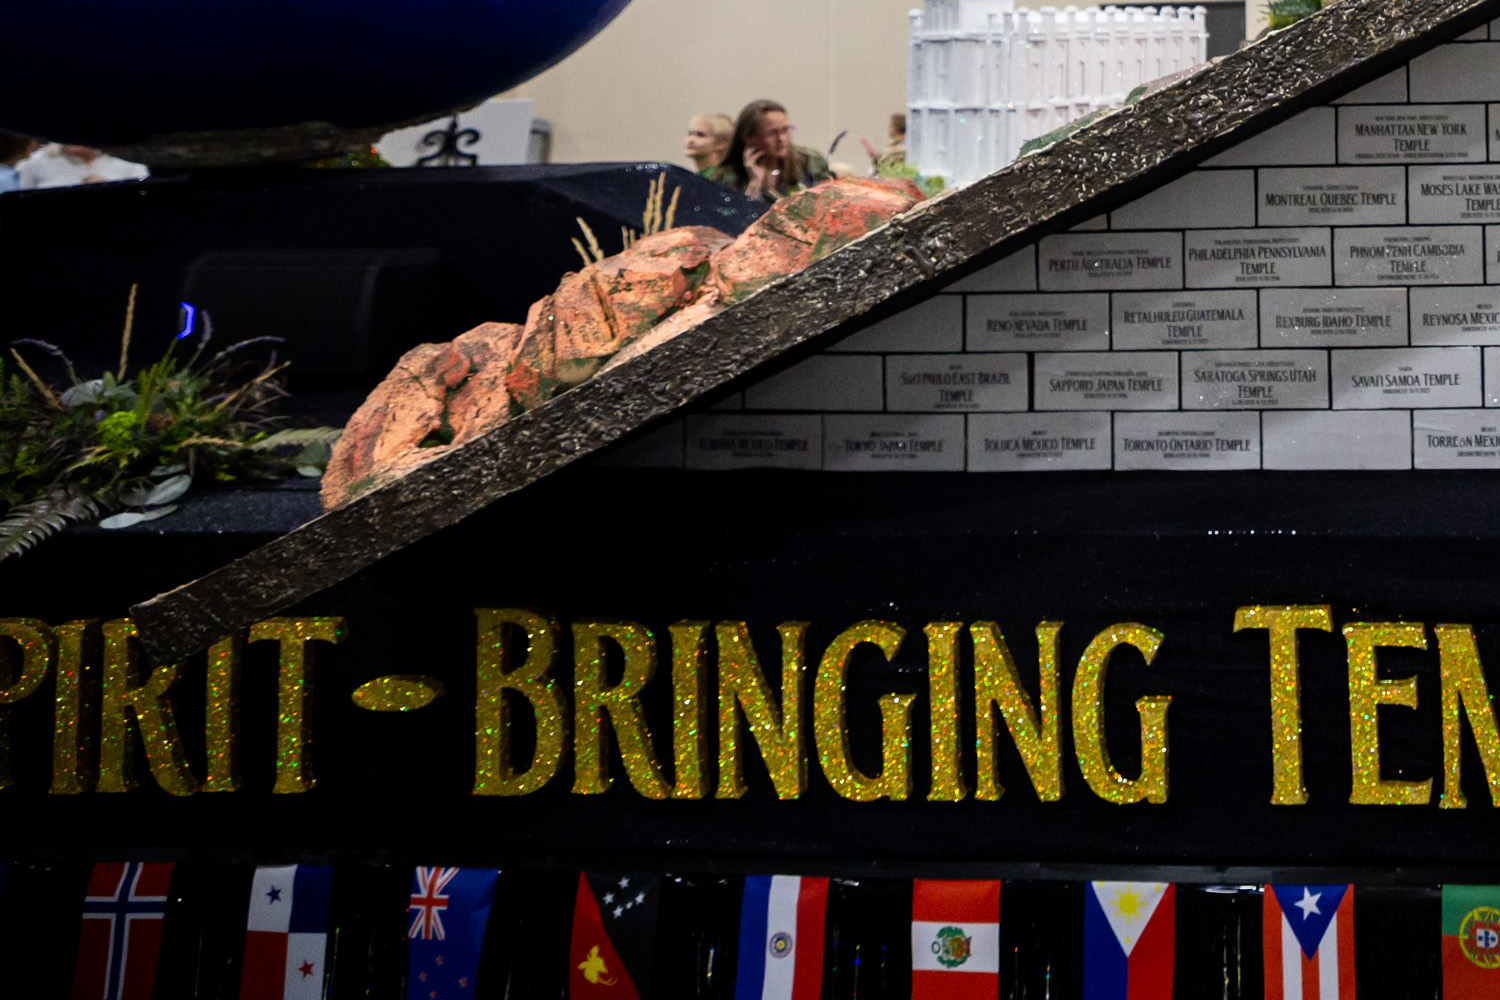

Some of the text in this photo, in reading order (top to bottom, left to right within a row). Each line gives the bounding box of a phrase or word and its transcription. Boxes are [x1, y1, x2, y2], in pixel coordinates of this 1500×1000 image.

[1354, 122, 1467, 137] MANHATTAN NEW YORK
[1393, 138, 1431, 152] TEMPLE
[1420, 183, 1455, 197] MOSES
[1454, 182, 1481, 197] LAKE
[1265, 192, 1397, 207] MONTREAL QUEBEC TEMPLE
[1188, 245, 1327, 261] PHILADELPHIA PENNSYLVANIA
[1240, 261, 1276, 275] TEMPLE
[1184, 308, 1245, 322] GUATEMALA
[1422, 313, 1469, 326] REYNOSA
[1167, 324, 1203, 338] TEMPLE
[1193, 369, 1318, 383] SARATOGA SPRINGS UTAH
[1048, 378, 1163, 392] SAPPORO JAPAN TEMPLE
[1237, 385, 1274, 399] TEMPLE
[983, 436, 1096, 452] TOLUCA MEXICO TEMPLE
[1123, 438, 1251, 452] TORONTO ONTARIO TEMPLE
[472, 607, 1173, 804] BRINGING
